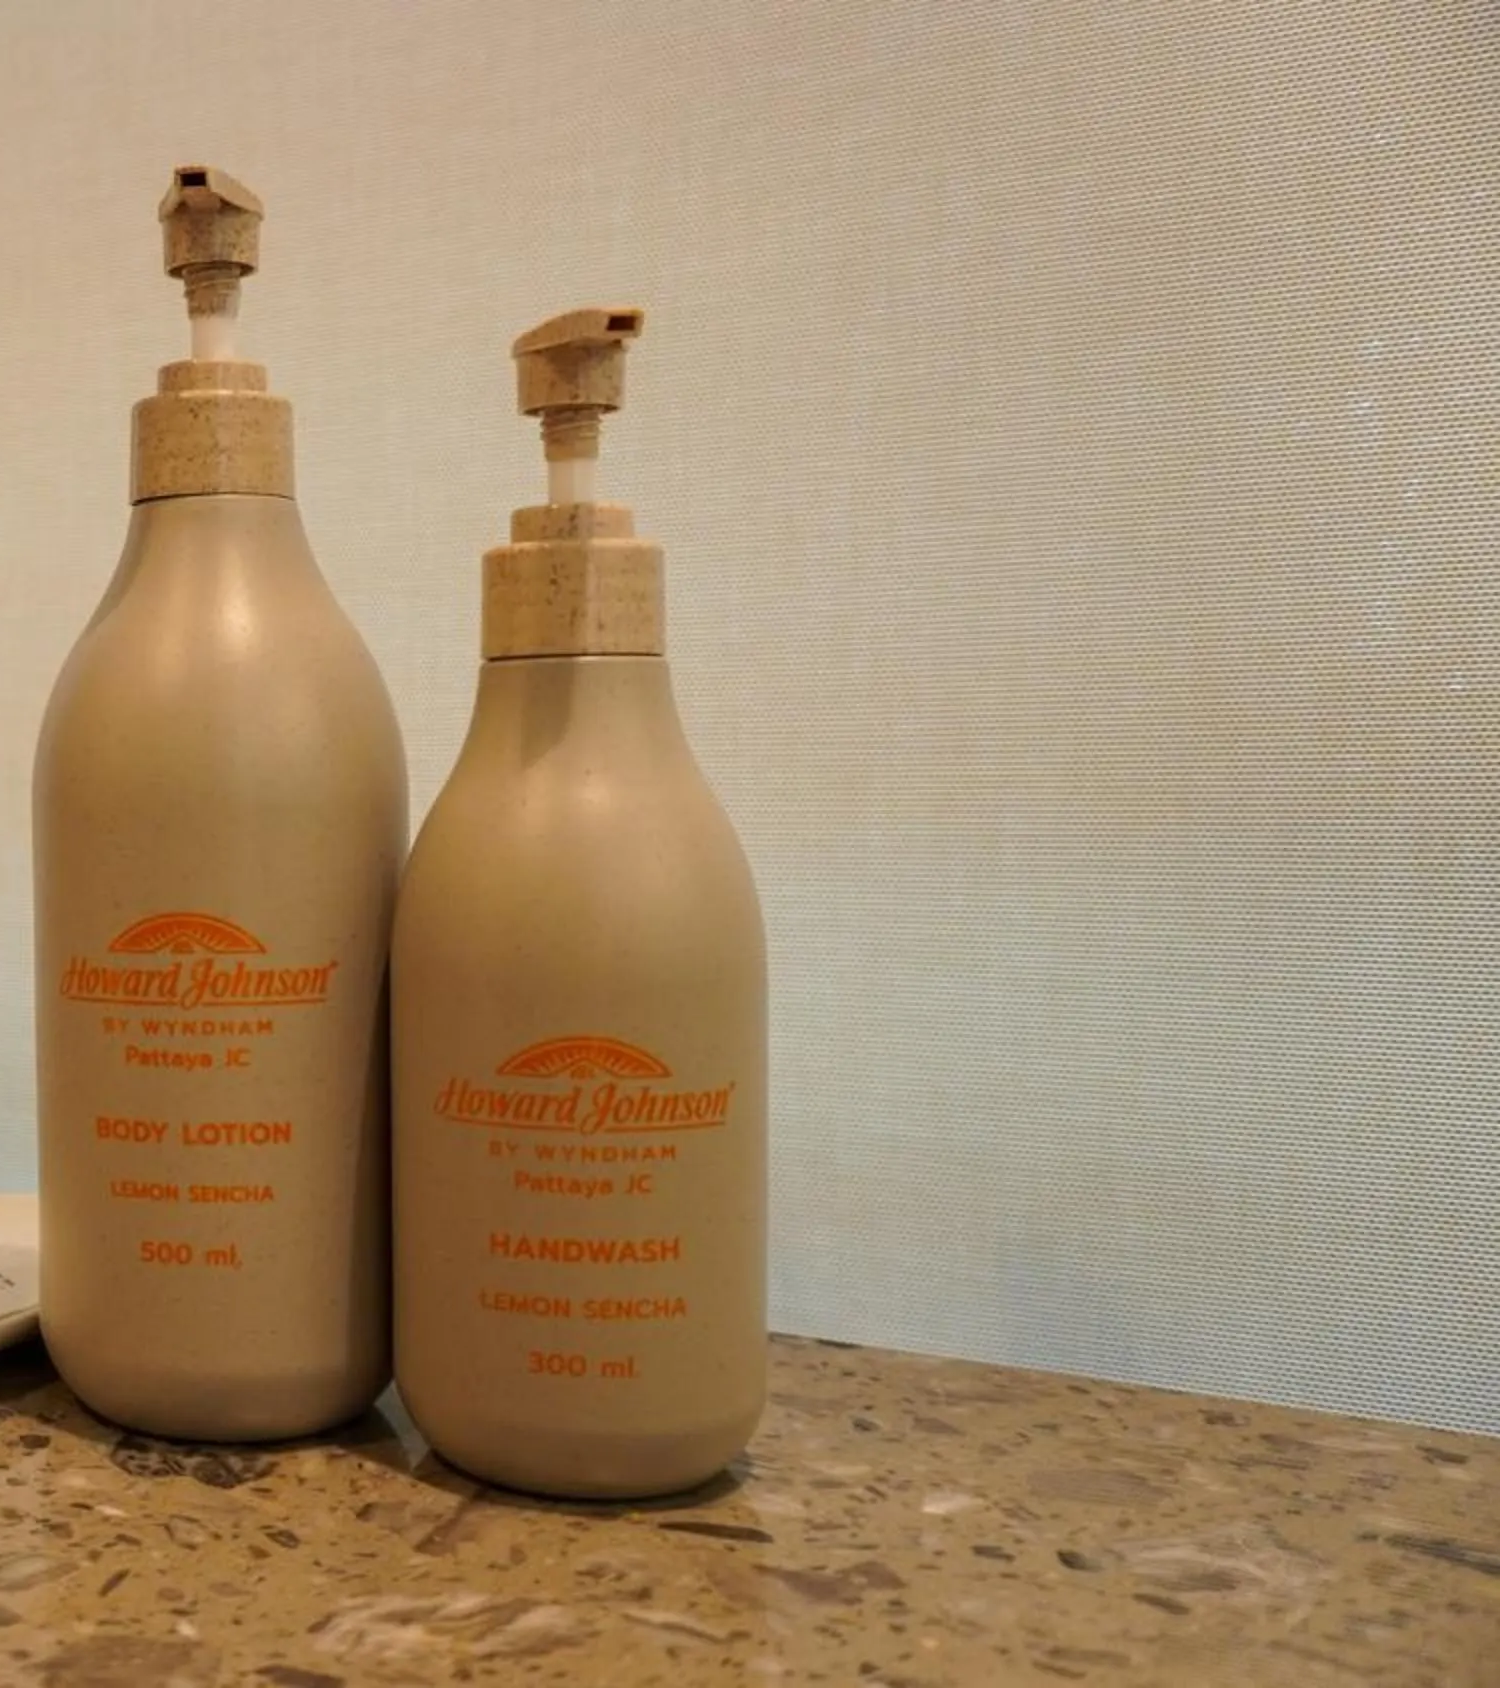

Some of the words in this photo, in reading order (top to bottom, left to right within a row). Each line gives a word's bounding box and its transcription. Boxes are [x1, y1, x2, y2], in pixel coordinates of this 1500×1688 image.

[59, 955, 182, 1000] Howard
[180, 958, 338, 1011] Johnson
[103, 1017, 127, 1034] BY
[140, 1019, 274, 1036] WYNDHAM
[125, 1046, 213, 1070] Pattaya
[433, 1077, 584, 1124] Howard
[579, 1081, 736, 1136] Johnson
[96, 1116, 169, 1143] BODY
[182, 1121, 293, 1146] LOTION
[489, 1140, 519, 1156] BY
[535, 1144, 677, 1163] WYNDHAM
[111, 1180, 180, 1201] LEMON
[189, 1184, 274, 1202] SENCHA
[514, 1170, 613, 1199] Pattaya
[140, 1241, 193, 1266] 500
[489, 1233, 680, 1264] HANDWASH
[480, 1290, 571, 1318] LEMON
[583, 1297, 688, 1320] SENCHA
[527, 1351, 587, 1377] 300
